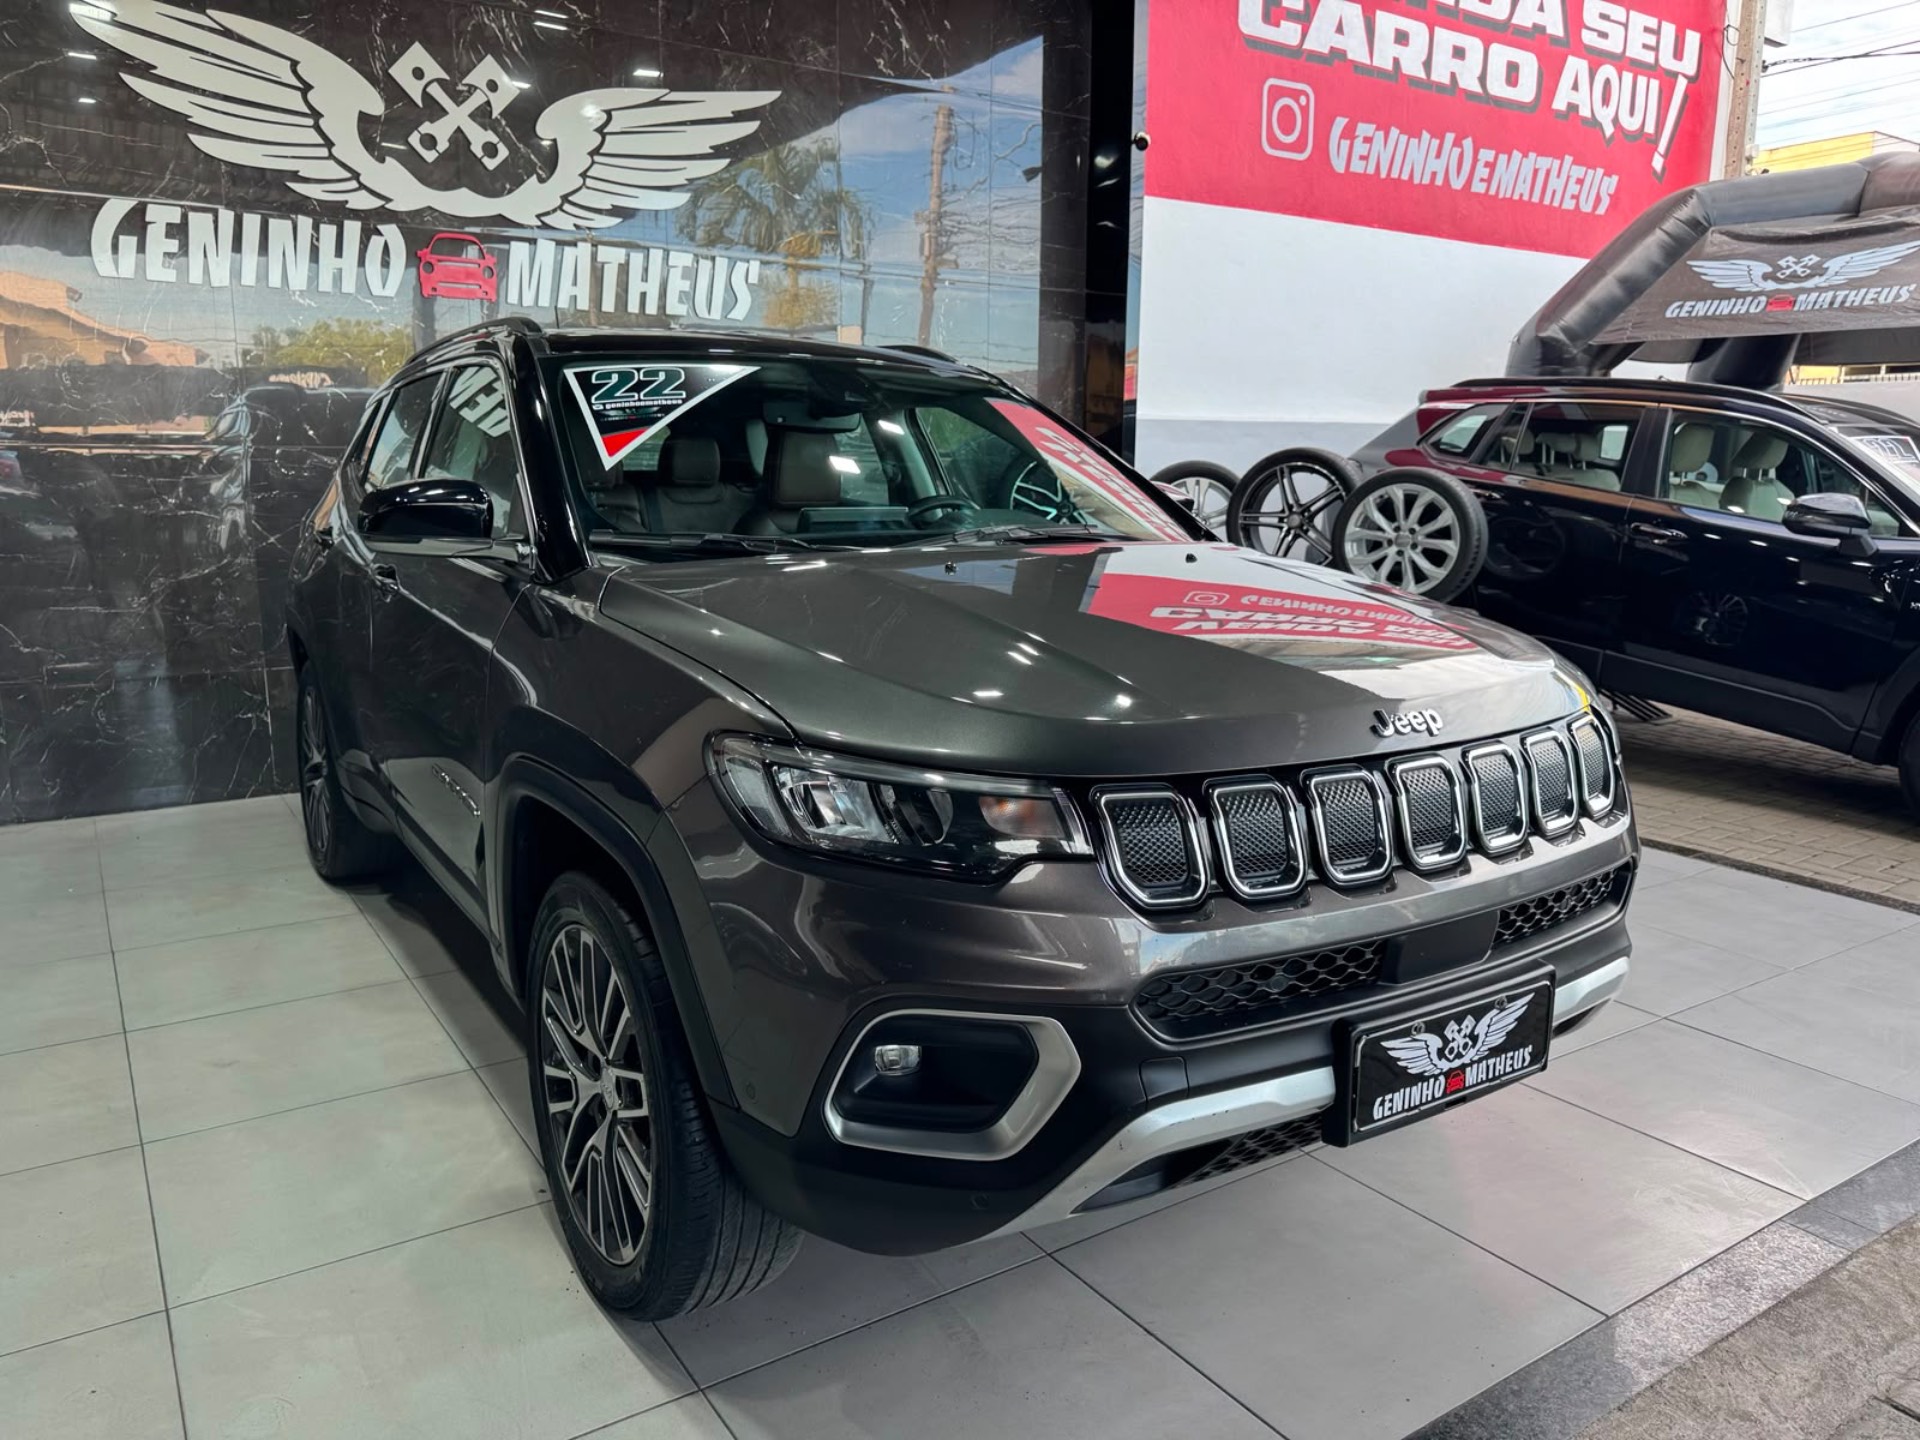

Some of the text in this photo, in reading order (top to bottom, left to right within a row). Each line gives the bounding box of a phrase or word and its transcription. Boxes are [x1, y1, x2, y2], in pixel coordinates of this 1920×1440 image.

[1238, 0, 1539, 103] CARRO
[1581, 0, 1701, 77] SEU
[91, 198, 760, 321] GENINHO MATHEUS
[1665, 284, 1917, 318] GENINHO MATHEUS
[591, 366, 686, 404] 22
[1369, 708, 1443, 738] Jeep
[1373, 1044, 1533, 1121] GENINHO MATHEUS
